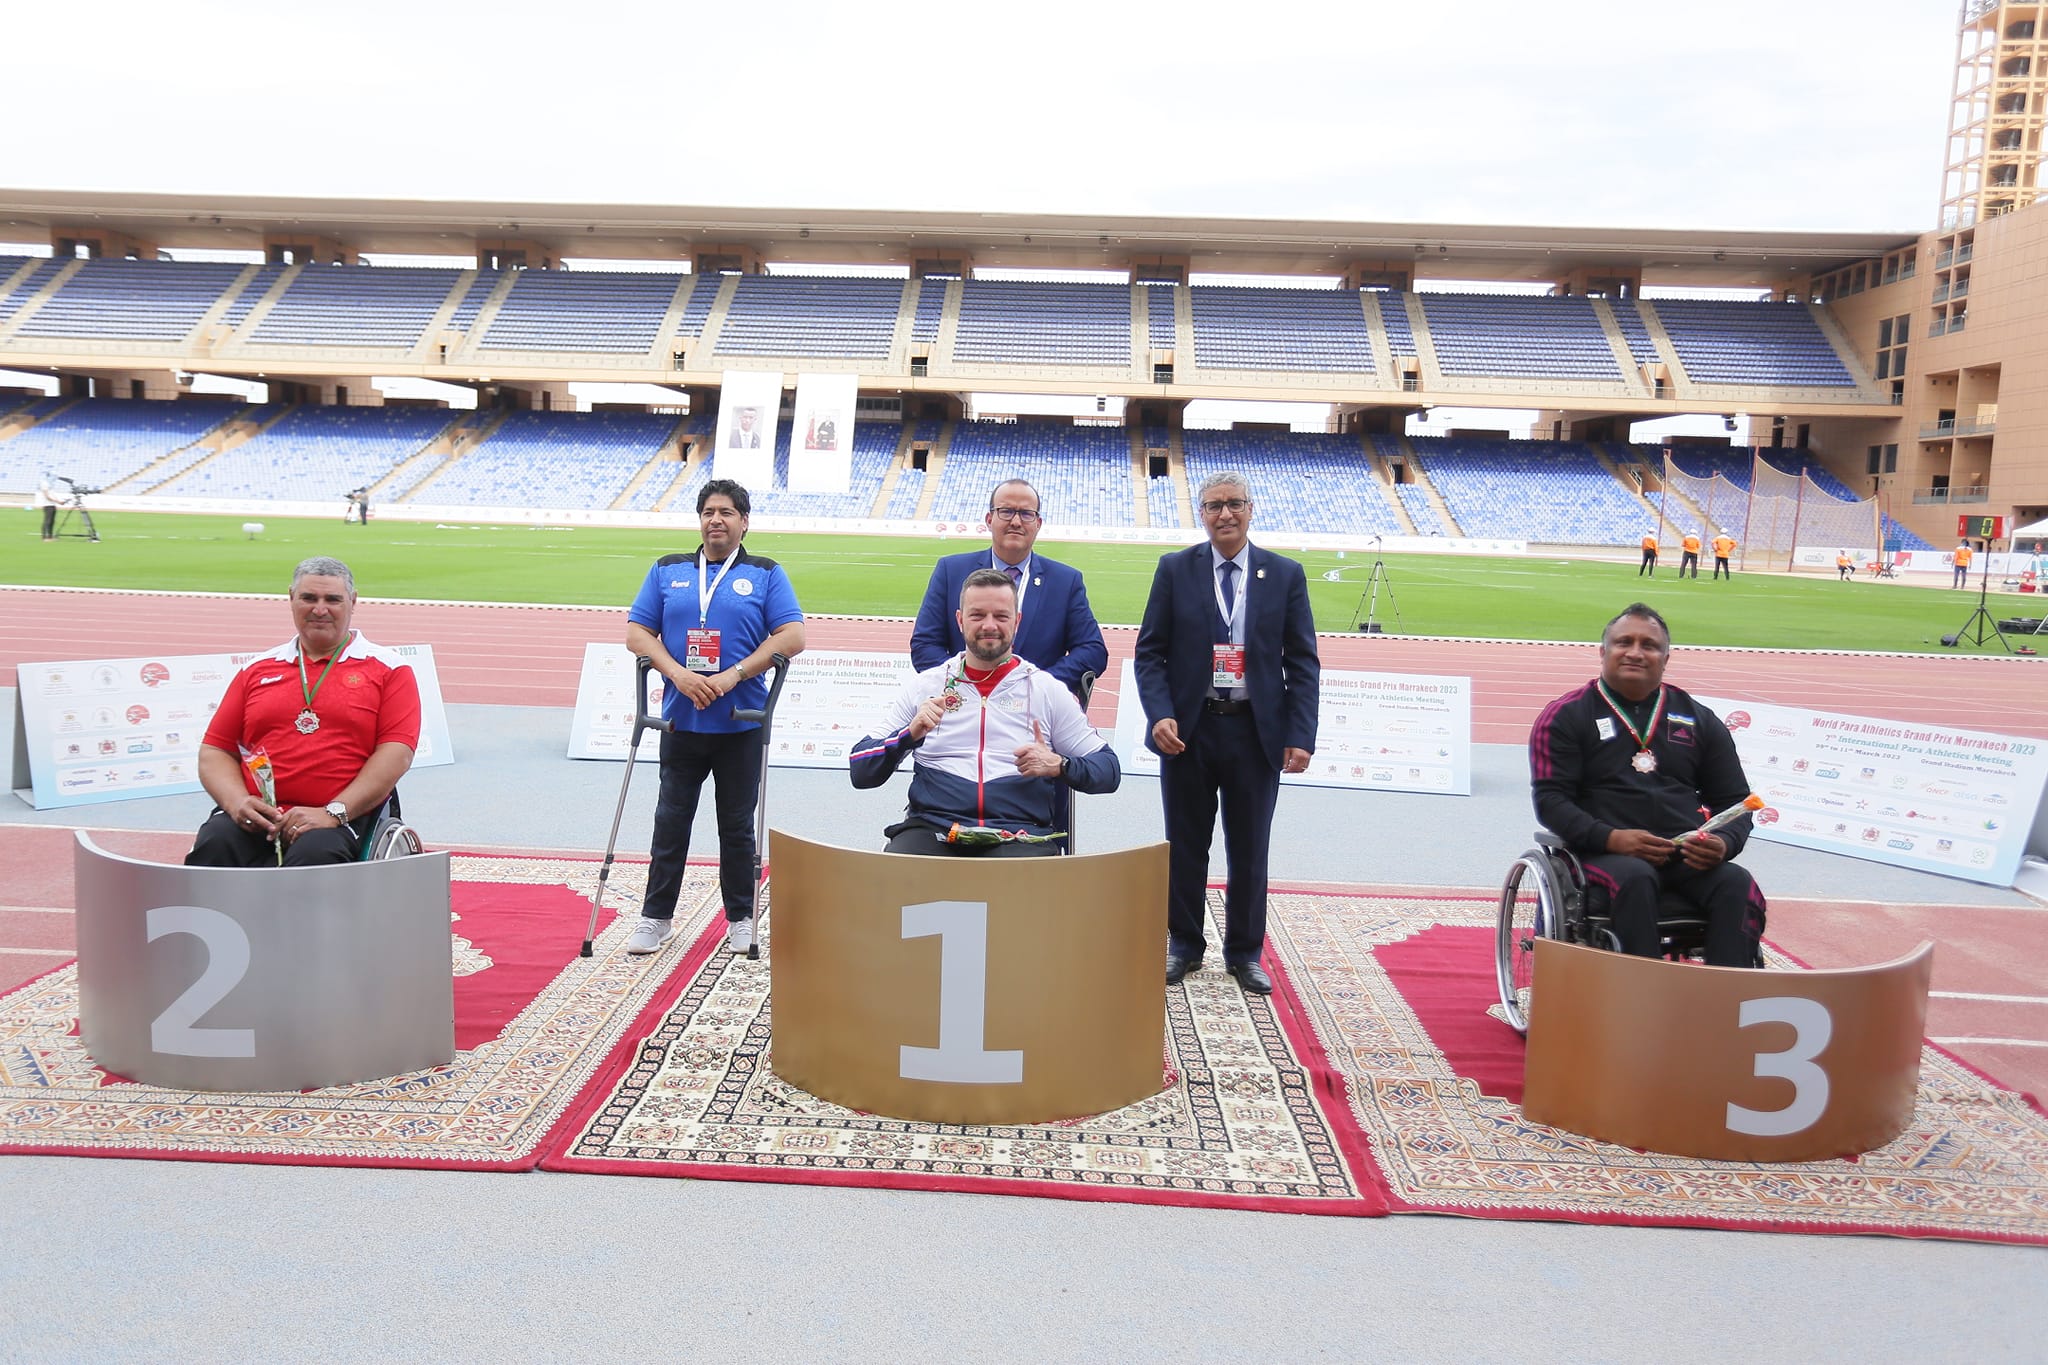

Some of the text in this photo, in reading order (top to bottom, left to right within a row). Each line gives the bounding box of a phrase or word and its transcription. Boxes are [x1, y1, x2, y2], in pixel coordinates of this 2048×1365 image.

[1981, 517, 1994, 537] 0
[790, 658, 911, 669] hletics Grand Prix Marrakech 2023
[816, 670, 833, 678] Para
[869, 672, 897, 680] Meeting
[1326, 678, 1358, 689] Athletics
[1360, 680, 1381, 690] Grand
[1383, 682, 1397, 691] Prix
[1399, 683, 1438, 693] Marrakech
[1439, 685, 1458, 694] 2023
[1812, 717, 2036, 755] World Para Athletics Grand Prix Marrakech 2023
[1838, 736, 1899, 751] International
[1901, 744, 1922, 754] Para
[1925, 747, 1970, 760] Athletics
[1972, 754, 2013, 767] Meeting
[146, 905, 256, 1058] 2
[900, 901, 1023, 1083] 1
[1725, 996, 1832, 1136] 3
